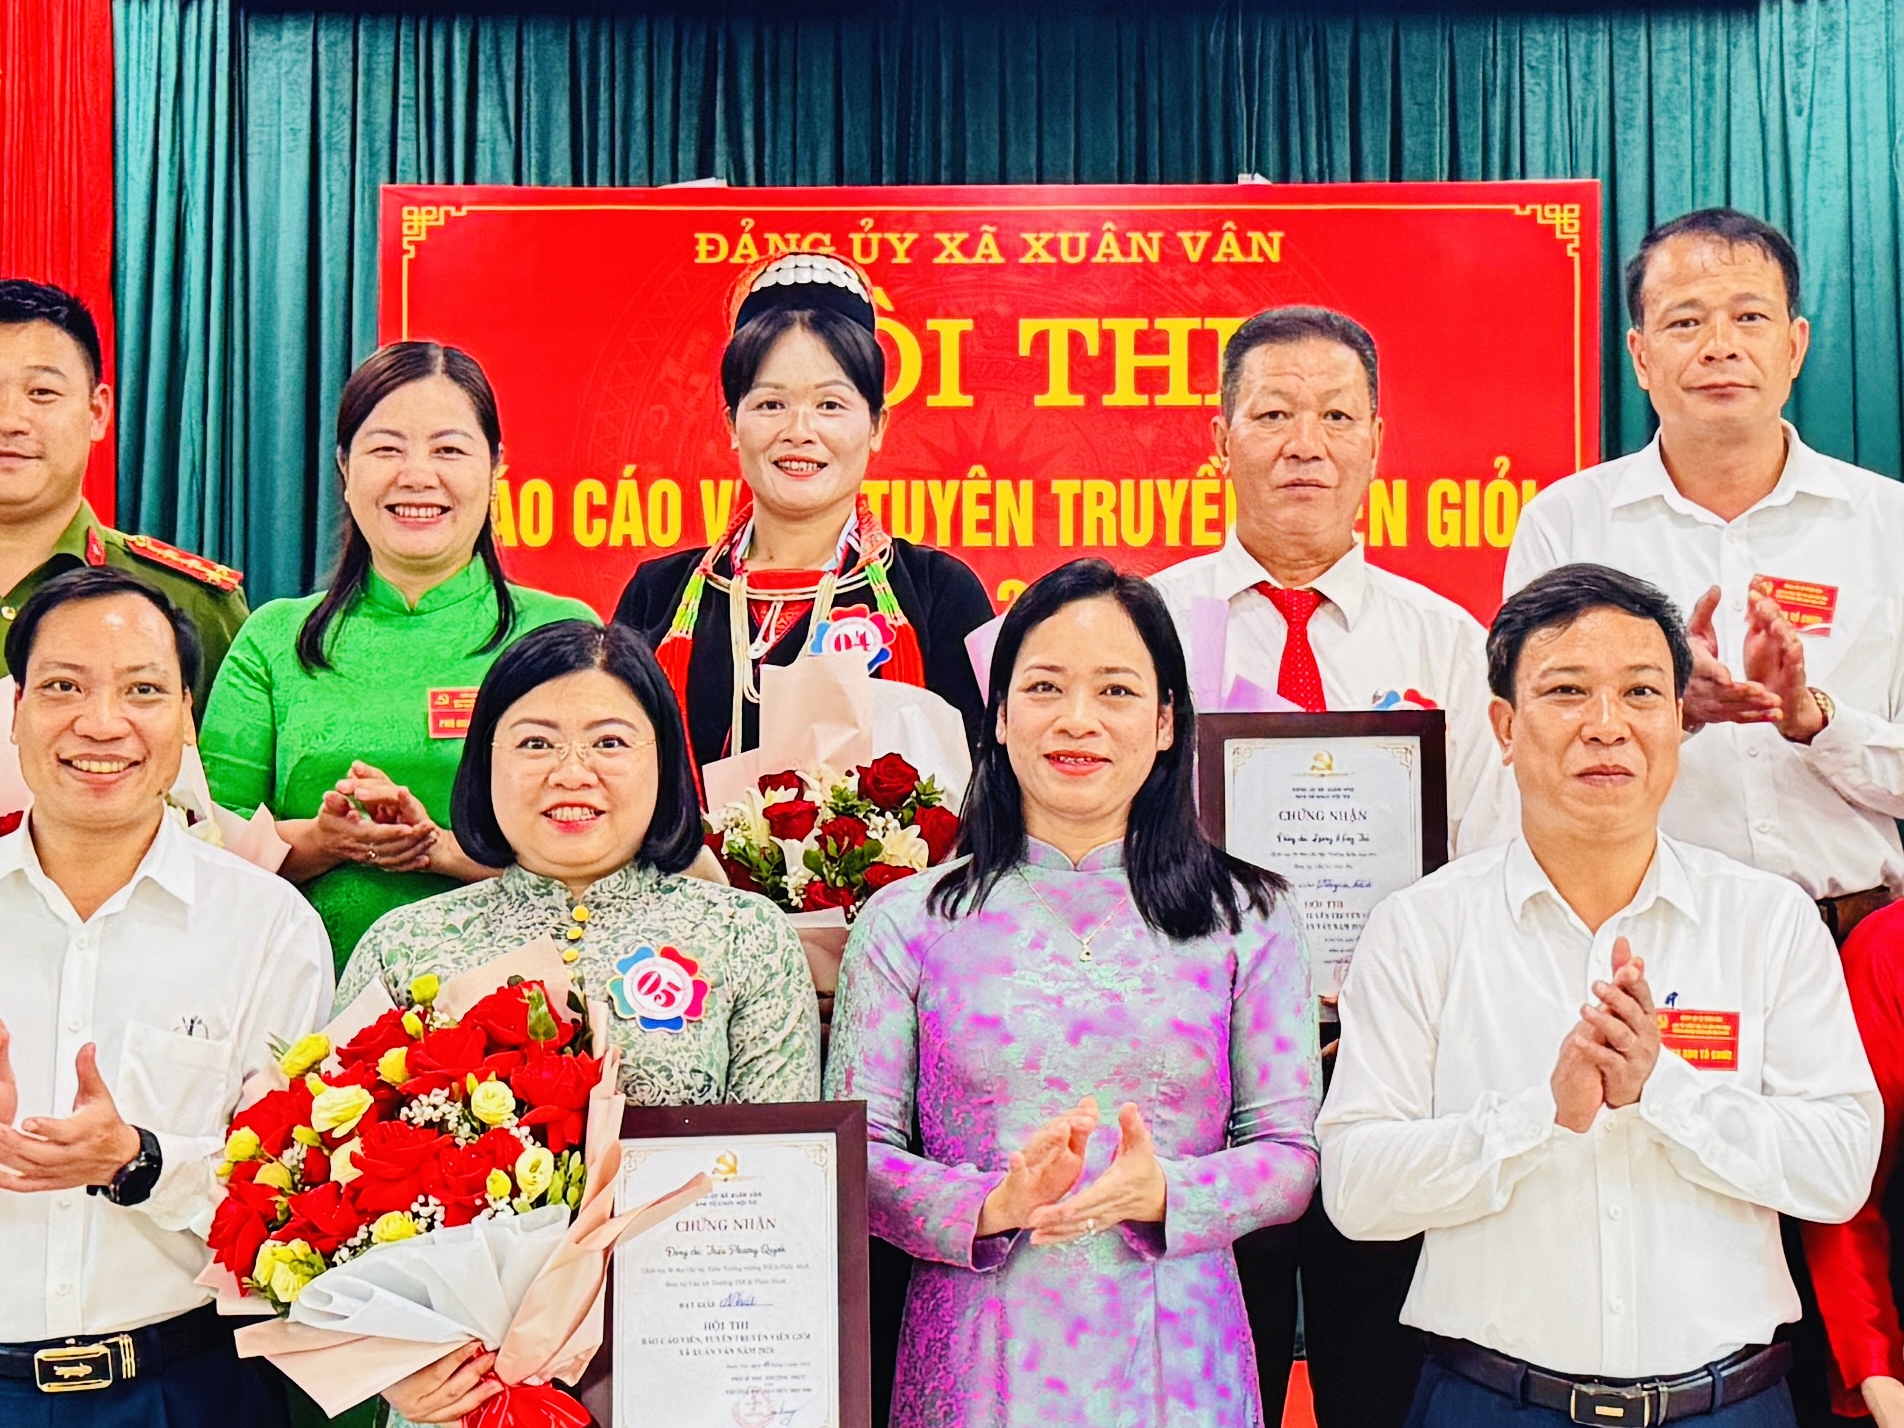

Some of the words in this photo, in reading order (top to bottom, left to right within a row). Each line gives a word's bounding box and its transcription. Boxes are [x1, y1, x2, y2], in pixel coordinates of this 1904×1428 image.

[693, 218, 837, 265] ĐẢNG
[848, 218, 920, 265] ỦY
[933, 224, 1005, 264] XÃ
[1019, 224, 1162, 264] XUÂN
[1177, 223, 1285, 264] VÂN
[493, 465, 554, 548] ÁO
[572, 465, 682, 548] CÁO
[861, 464, 1034, 548] TUYÊN
[833, 629, 871, 653] 04
[637, 970, 683, 1008] 05
[675, 1216, 728, 1233] CHỨNG
[733, 1215, 777, 1233] NHẬN
[704, 1319, 725, 1333] HỘI
[728, 1320, 749, 1331] THI
